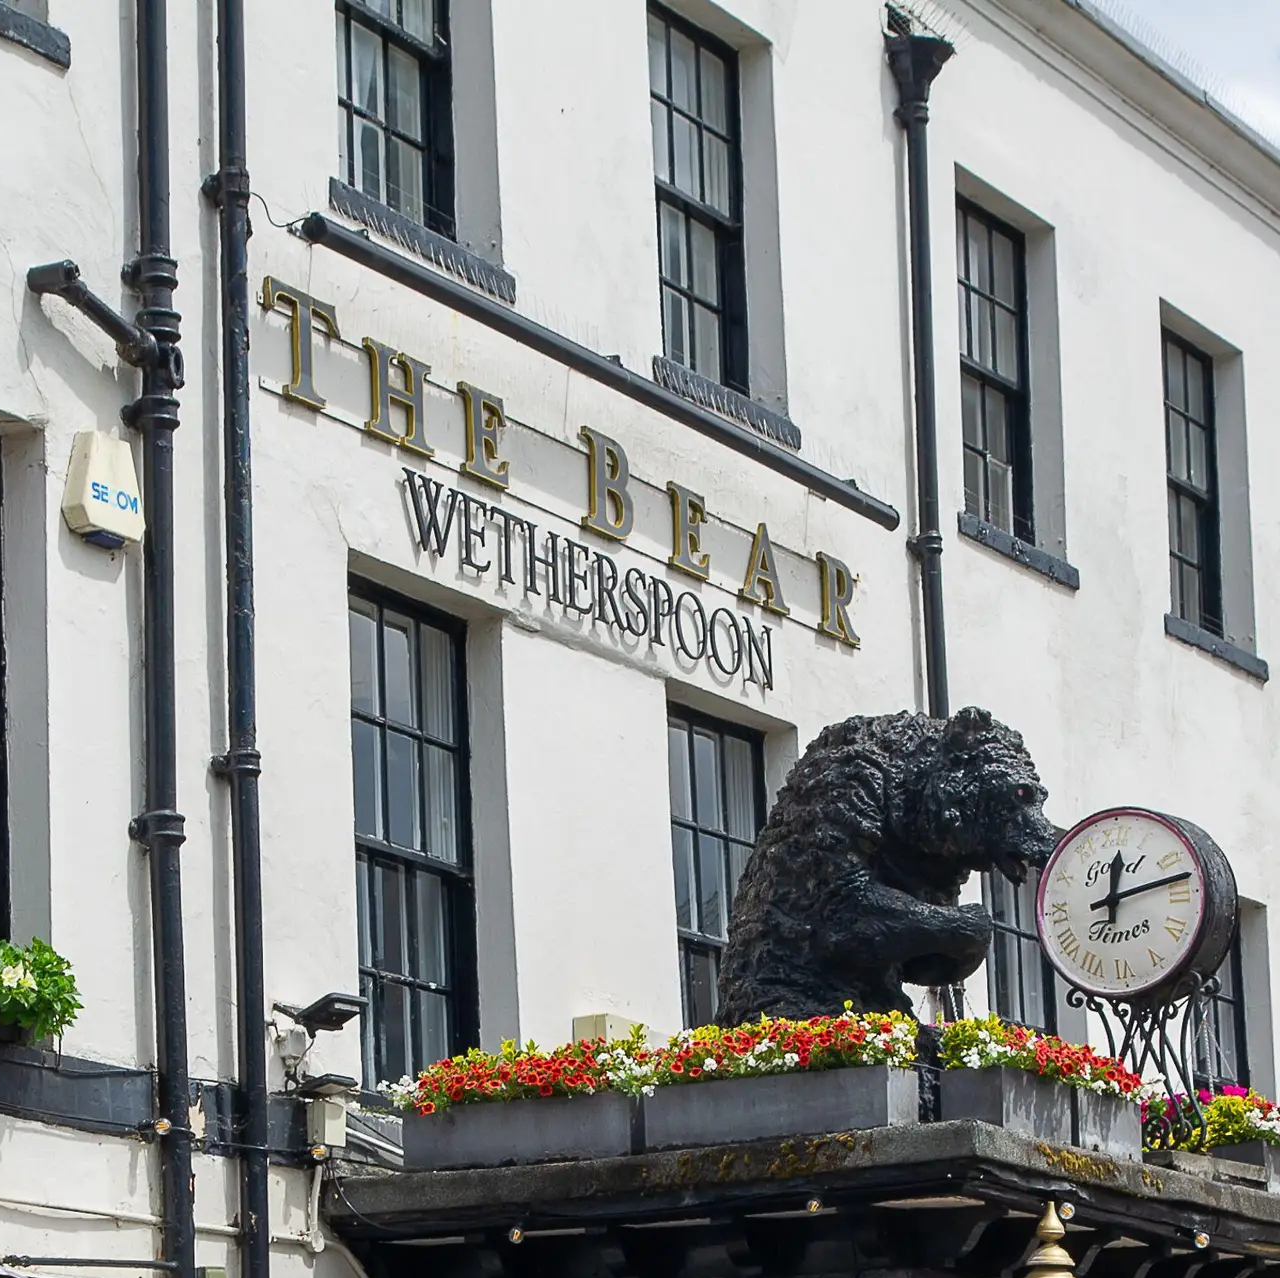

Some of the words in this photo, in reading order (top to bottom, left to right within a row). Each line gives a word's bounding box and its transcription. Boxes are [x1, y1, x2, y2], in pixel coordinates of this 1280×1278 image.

[262, 275, 510, 490] THE
[578, 425, 862, 652] BEAR
[401, 467, 774, 692] WETHERSPOON
[1088, 919, 1151, 944] Times
